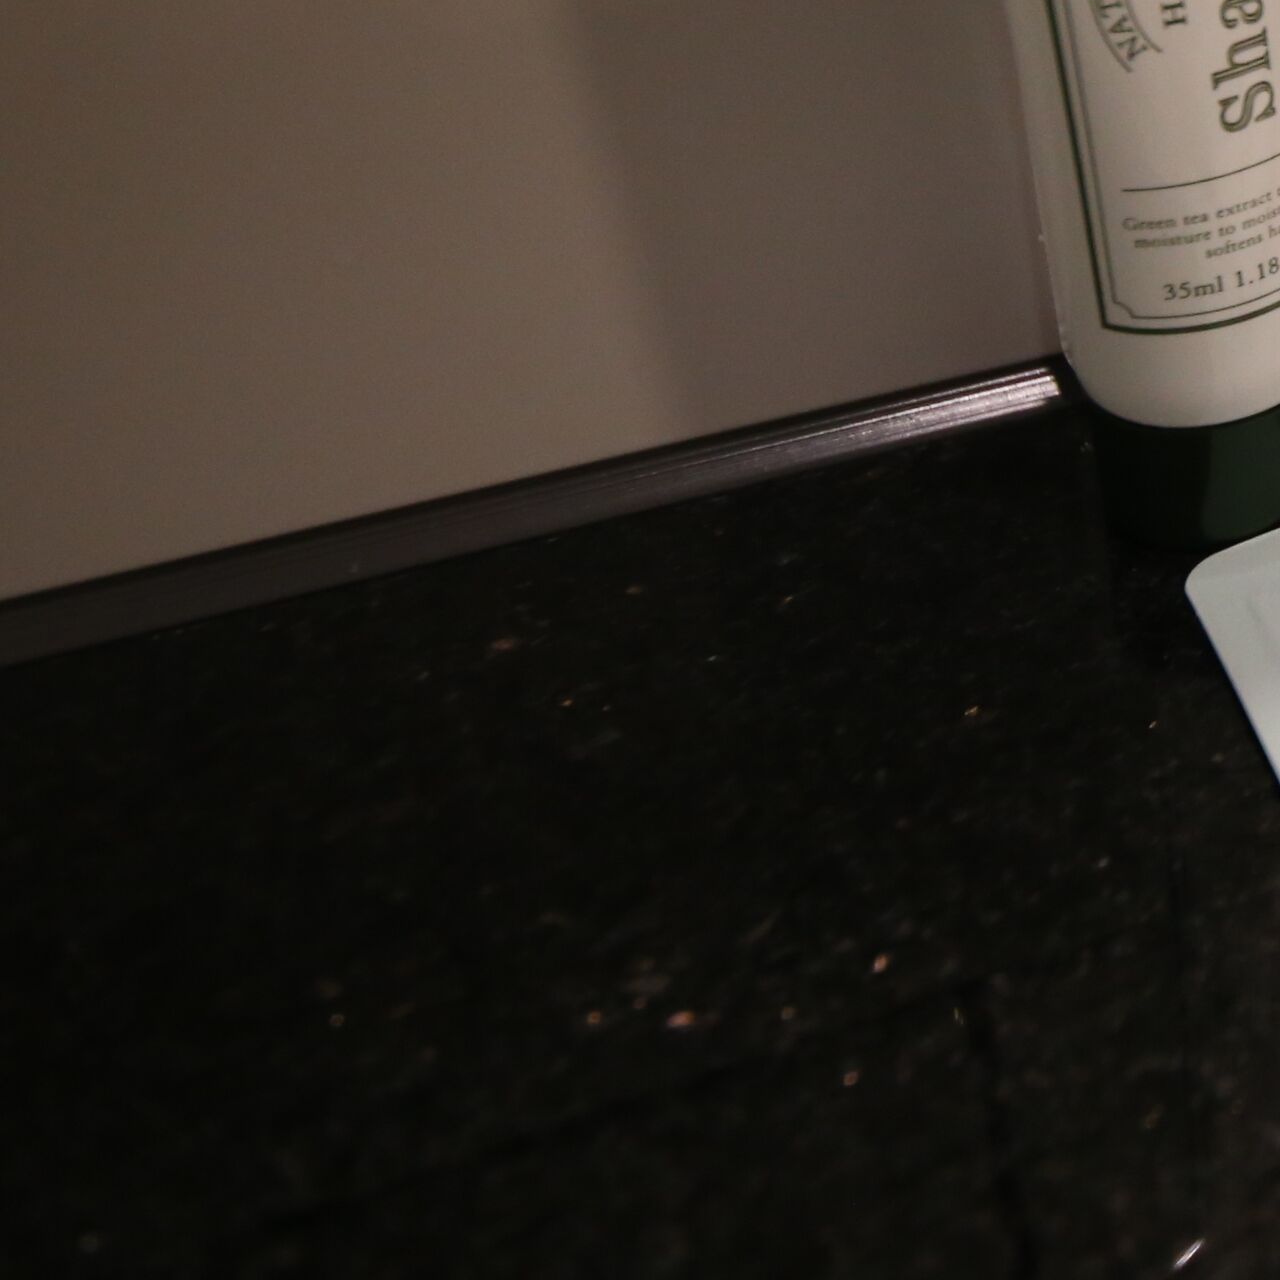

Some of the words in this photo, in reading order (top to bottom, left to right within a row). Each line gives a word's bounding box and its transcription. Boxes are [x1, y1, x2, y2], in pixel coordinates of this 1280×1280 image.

[1122, 217, 1178, 232] Green
[1183, 213, 1209, 227] tea
[1215, 191, 1273, 219] extract
[1133, 231, 1212, 249] moisture
[1218, 226, 1237, 237] to
[1205, 233, 1264, 259] softens
[1163, 274, 1225, 301] 35ml
[1235, 256, 1280, 288] 1.18
